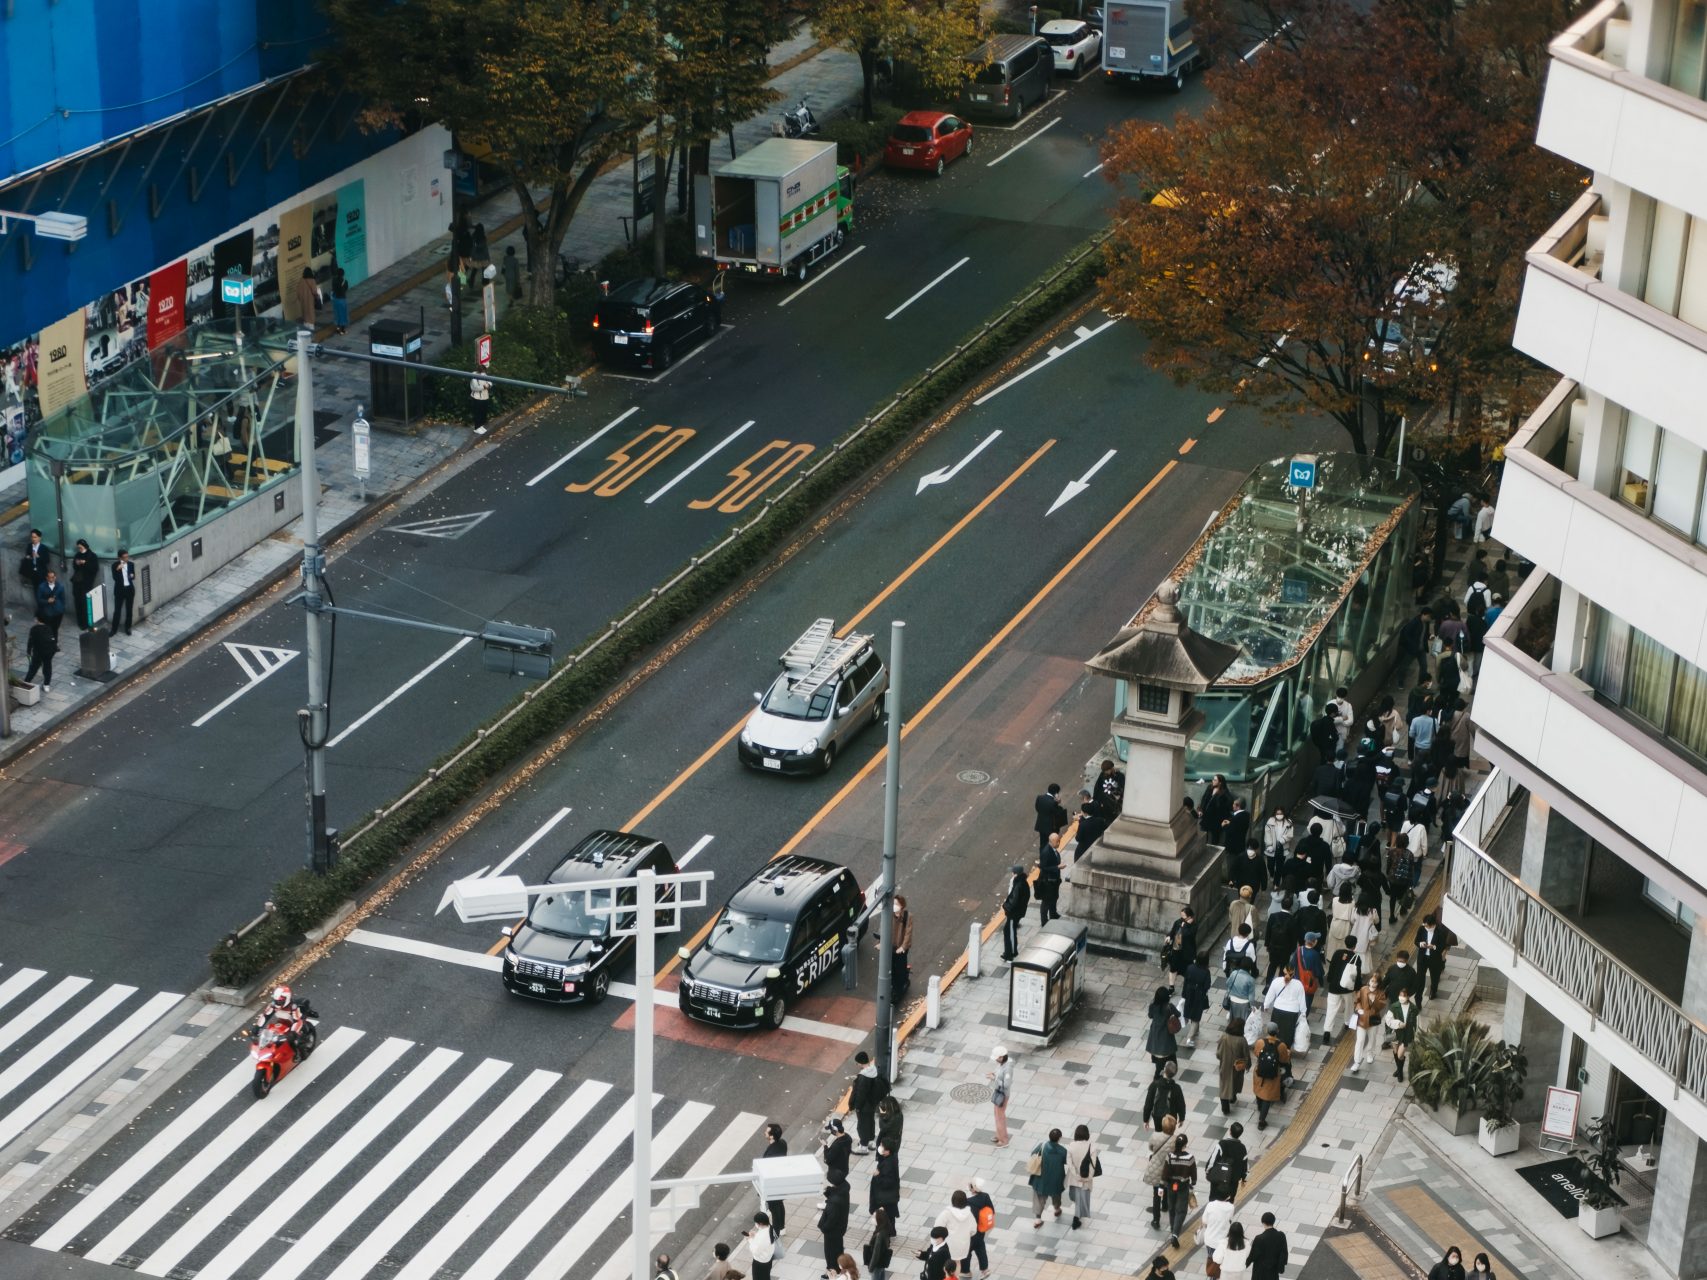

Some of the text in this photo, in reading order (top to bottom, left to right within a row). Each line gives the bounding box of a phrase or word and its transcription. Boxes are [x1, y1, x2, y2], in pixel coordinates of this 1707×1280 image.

[49, 344, 67, 362] 1980
[564, 424, 697, 497] 50
[687, 440, 816, 513] 50
[1551, 1172, 1588, 1201] anello
